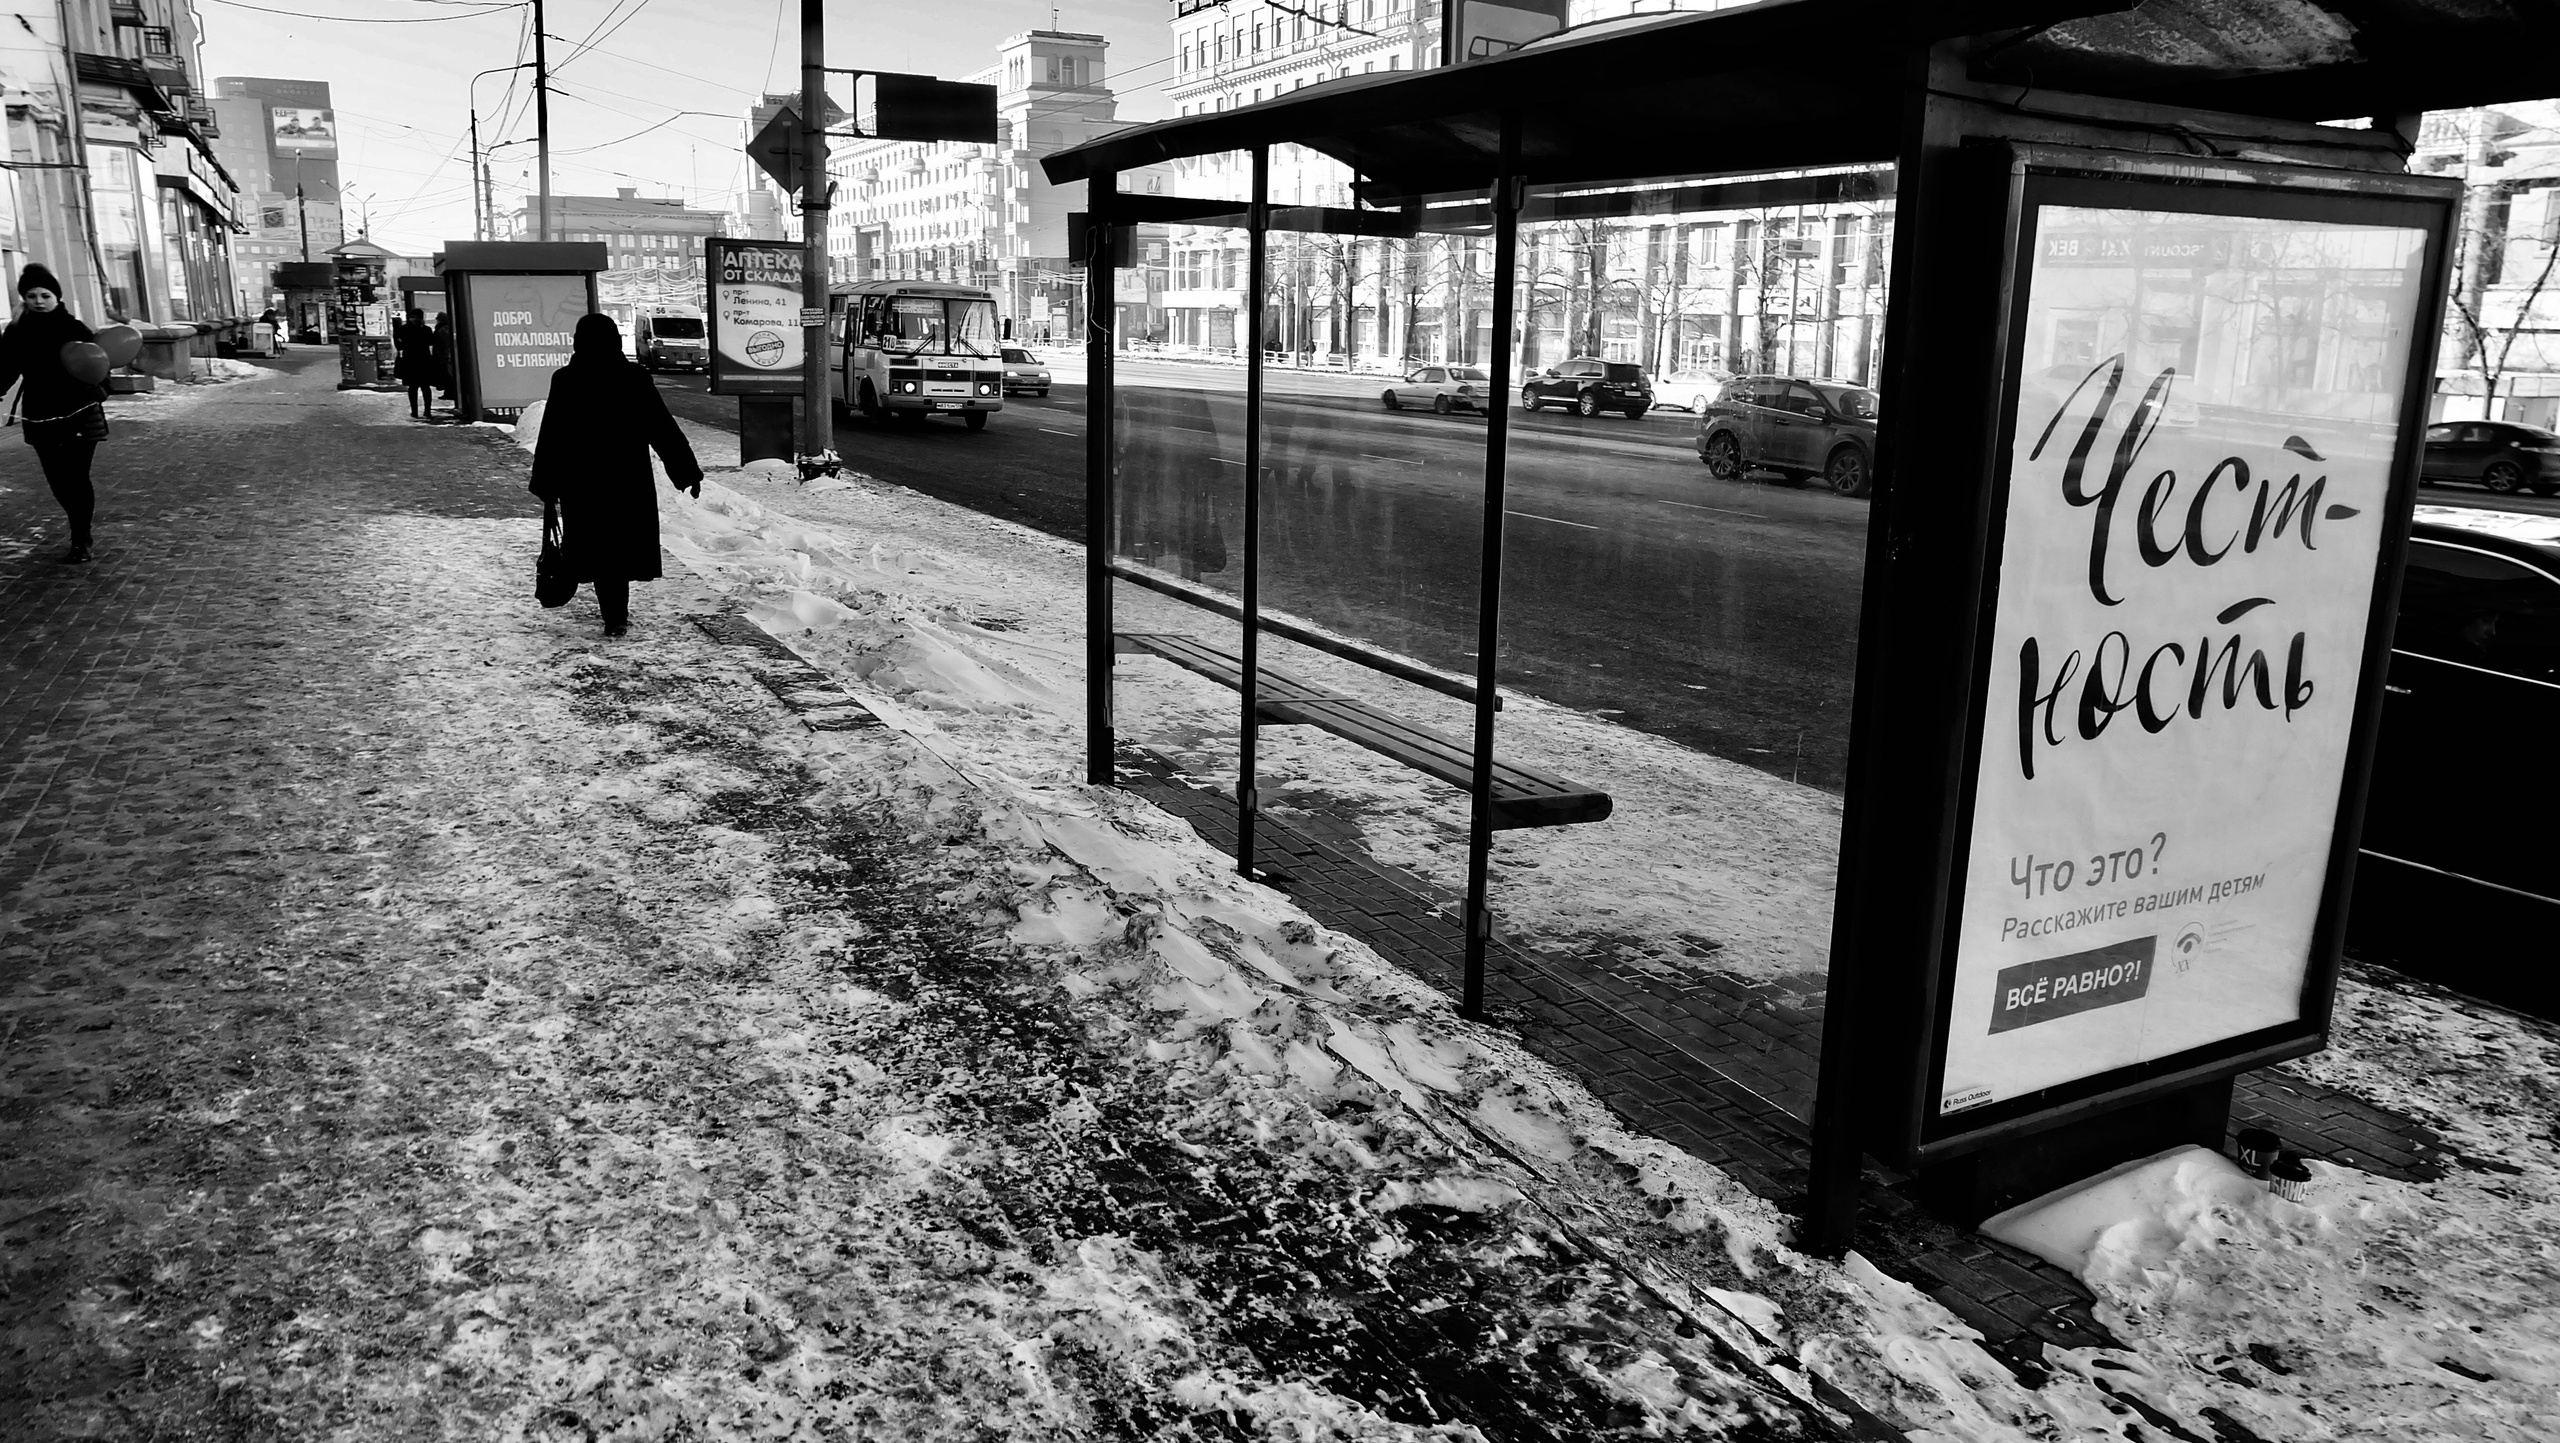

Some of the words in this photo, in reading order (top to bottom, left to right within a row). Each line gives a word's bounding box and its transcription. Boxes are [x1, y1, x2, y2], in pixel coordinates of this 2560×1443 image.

[724, 251, 802, 270] АПТЕКА
[724, 269, 742, 281] ОТ
[744, 270, 803, 283] СКЛАДА
[733, 297, 772, 306] Ленина,
[775, 297, 787, 306] 41
[493, 312, 532, 327] ДОБРО
[733, 317, 784, 327] Комарова,
[494, 332, 574, 346] ПОЖАЛОВАТЬ
[748, 341, 783, 354] ВЫГОДНО
[497, 354, 505, 367] В
[2019, 597, 2314, 780] ность
[2010, 854, 2075, 899] Что
[2085, 832, 2167, 887] это?
[2001, 899, 2128, 942] Расскажите
[2133, 885, 2204, 915] вашим
[2208, 873, 2266, 904] детям
[2005, 977, 2049, 1011] ВСЁ
[2052, 960, 2142, 999] РАВНО?!
[2240, 1145, 2261, 1167] XL
